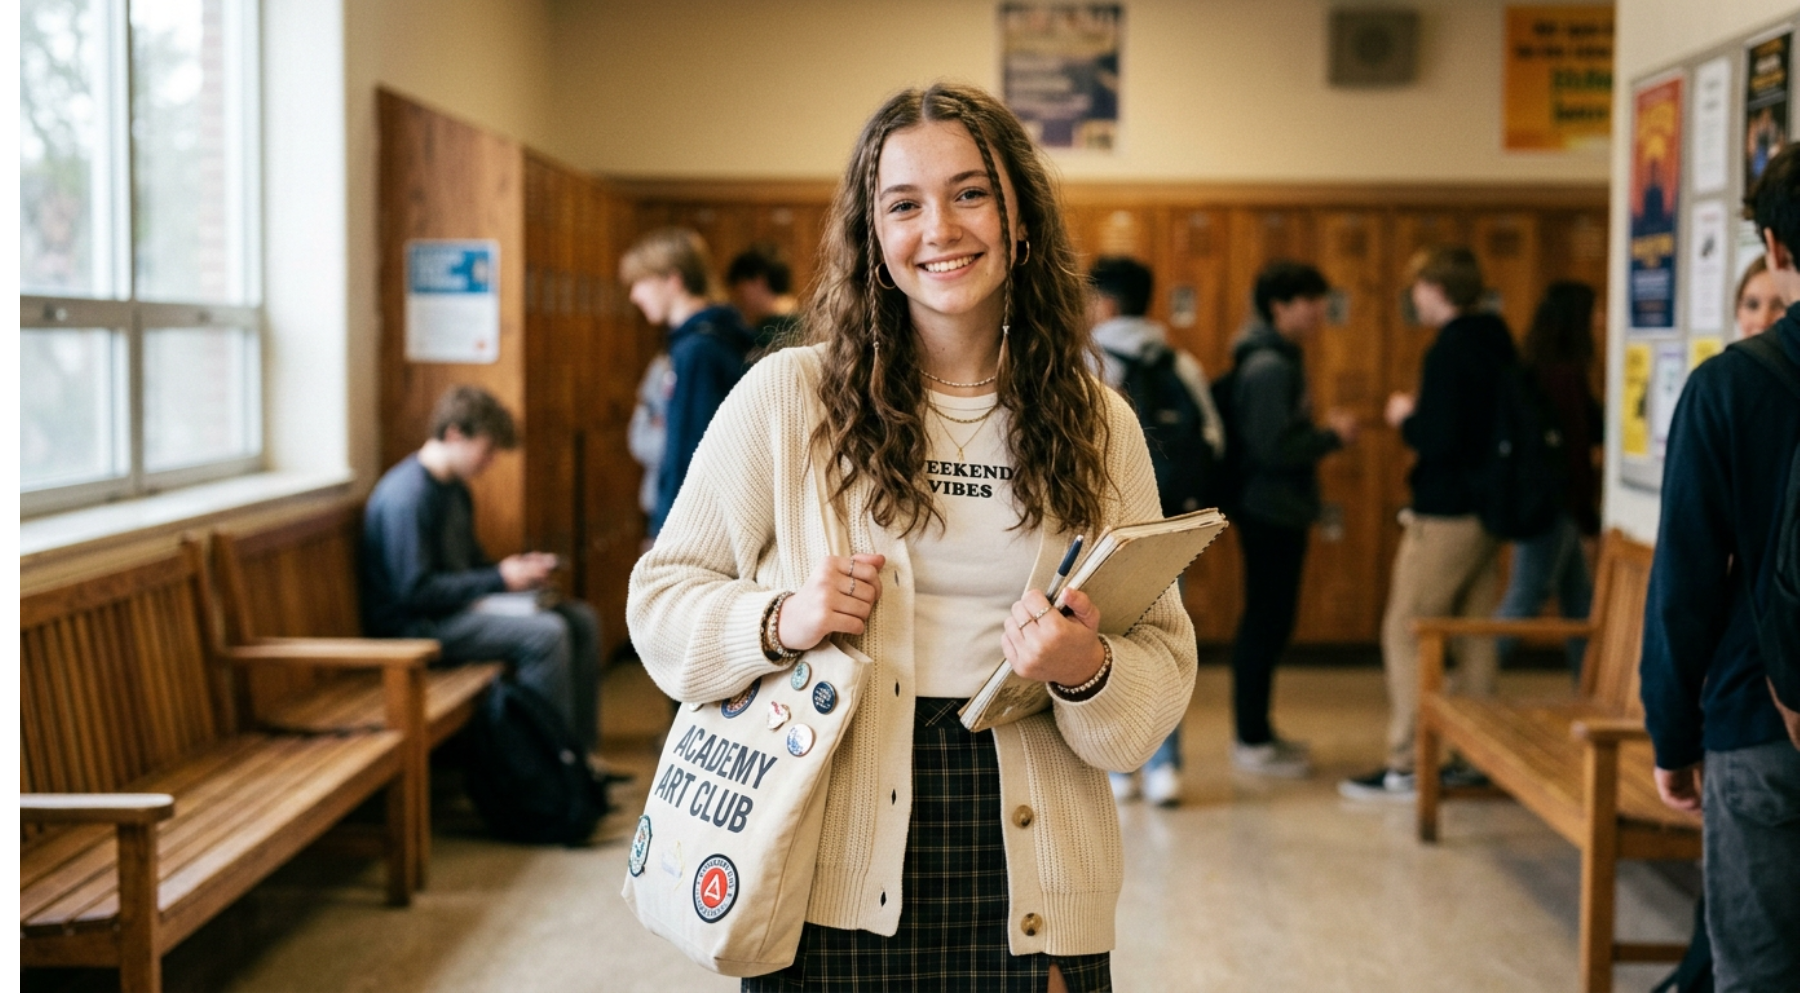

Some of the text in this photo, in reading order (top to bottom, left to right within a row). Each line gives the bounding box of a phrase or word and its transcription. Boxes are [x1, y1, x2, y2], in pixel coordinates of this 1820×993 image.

[925, 460, 1013, 480] EEKEND
[928, 480, 993, 498] VIBES
[673, 724, 778, 790] ACADEMY
[654, 764, 754, 833] ART CLUB
